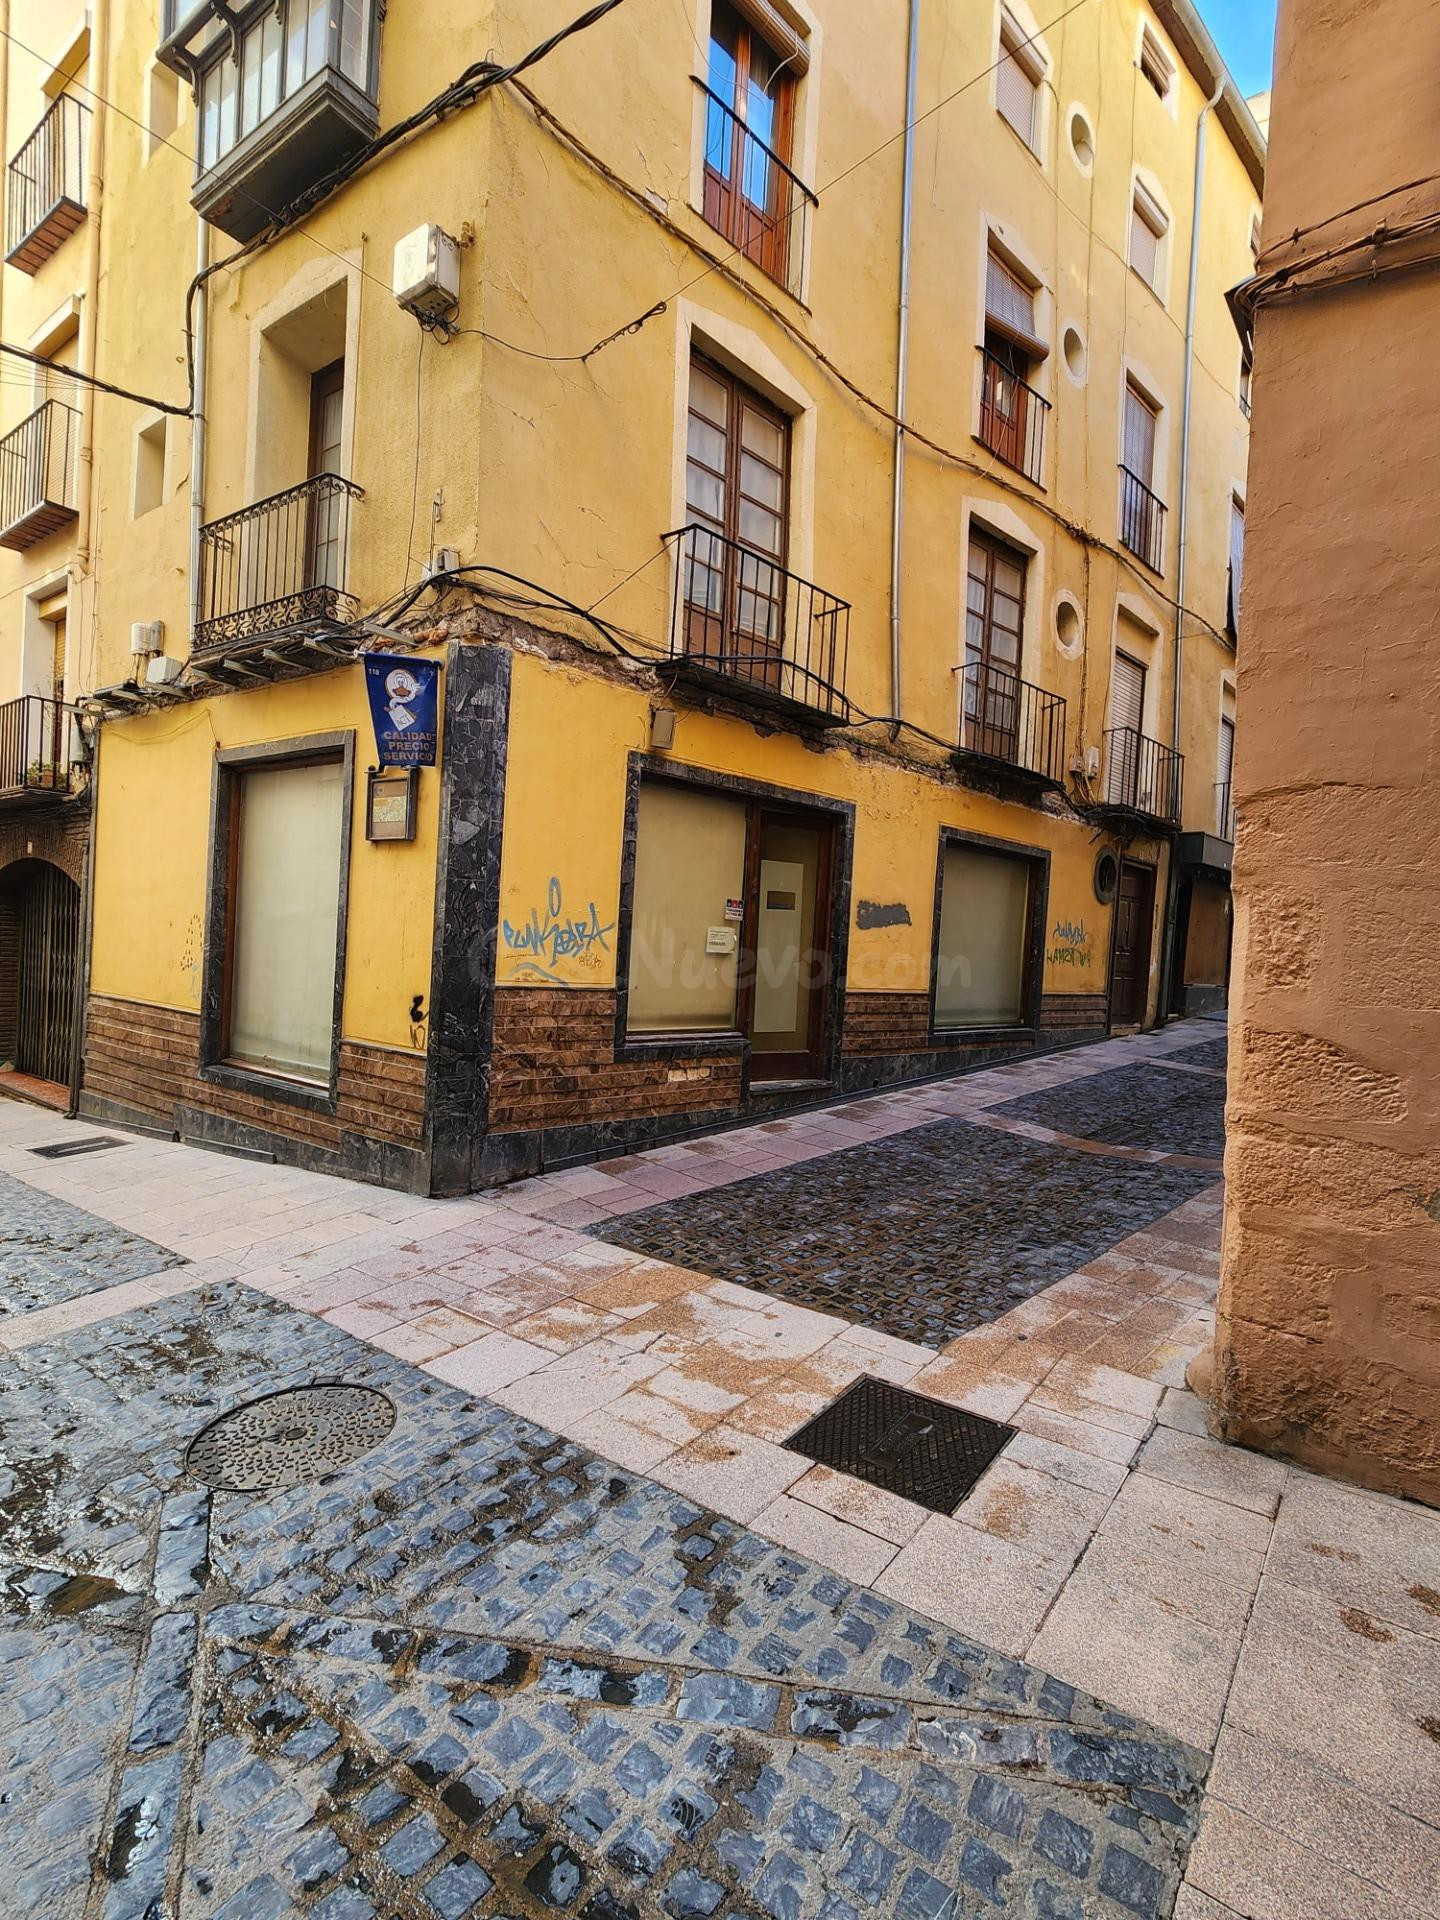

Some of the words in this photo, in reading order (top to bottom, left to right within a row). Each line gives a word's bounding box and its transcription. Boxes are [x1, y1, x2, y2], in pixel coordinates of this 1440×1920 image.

[384, 731, 432, 741] CALIDAD
[388, 741, 430, 751] PRECIO
[384, 752, 433, 761] SERVICIO
